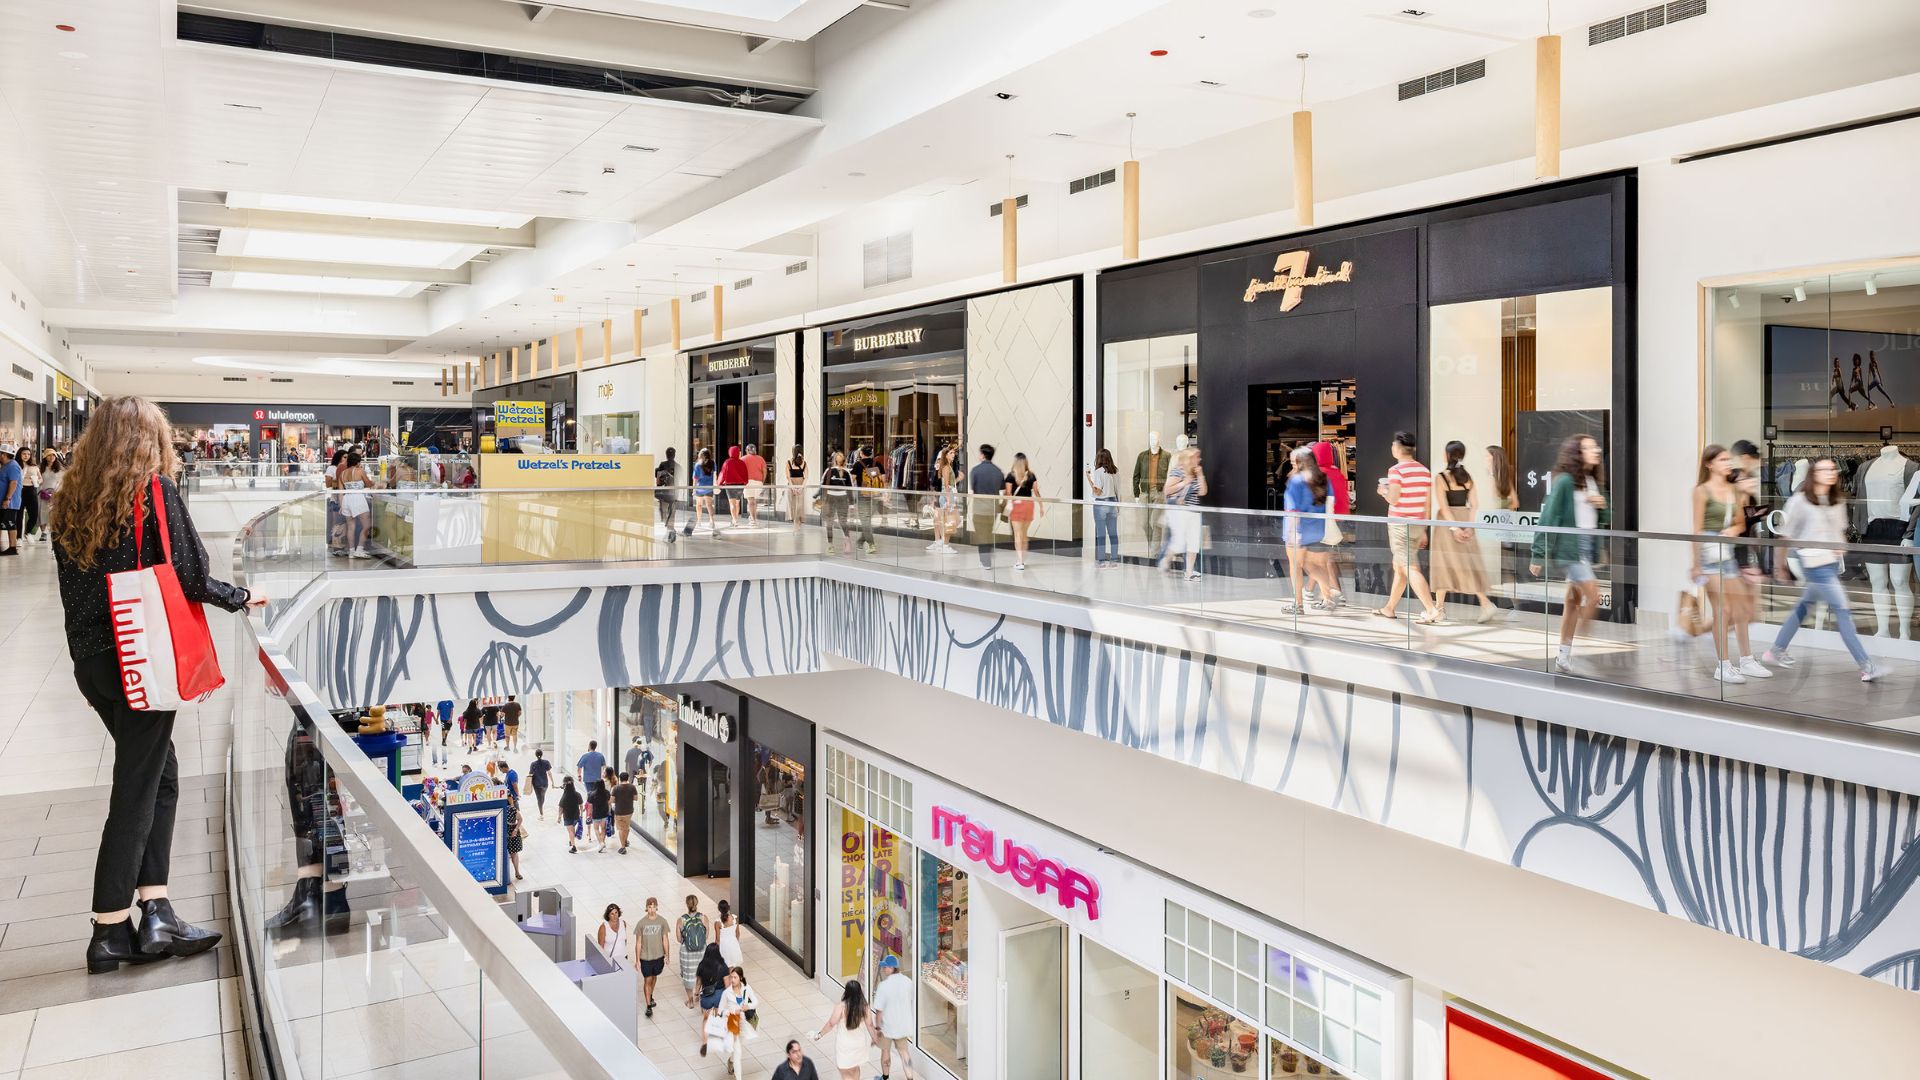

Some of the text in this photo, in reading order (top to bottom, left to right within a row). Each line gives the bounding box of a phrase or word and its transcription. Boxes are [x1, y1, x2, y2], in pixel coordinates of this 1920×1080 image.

[1273, 250, 1310, 311] 7
[854, 327, 923, 352] BURBERRY
[708, 355, 751, 372] BURBERRY
[268, 410, 315, 420] lululemon
[497, 405, 544, 414] Wetzel's
[497, 414, 545, 423] Pretzels
[517, 459, 621, 470] Wetzel's Pretzels
[677, 694, 719, 739] Timberland
[448, 789, 506, 804] WORKSHOP
[842, 849, 893, 863] CHOCLATE
